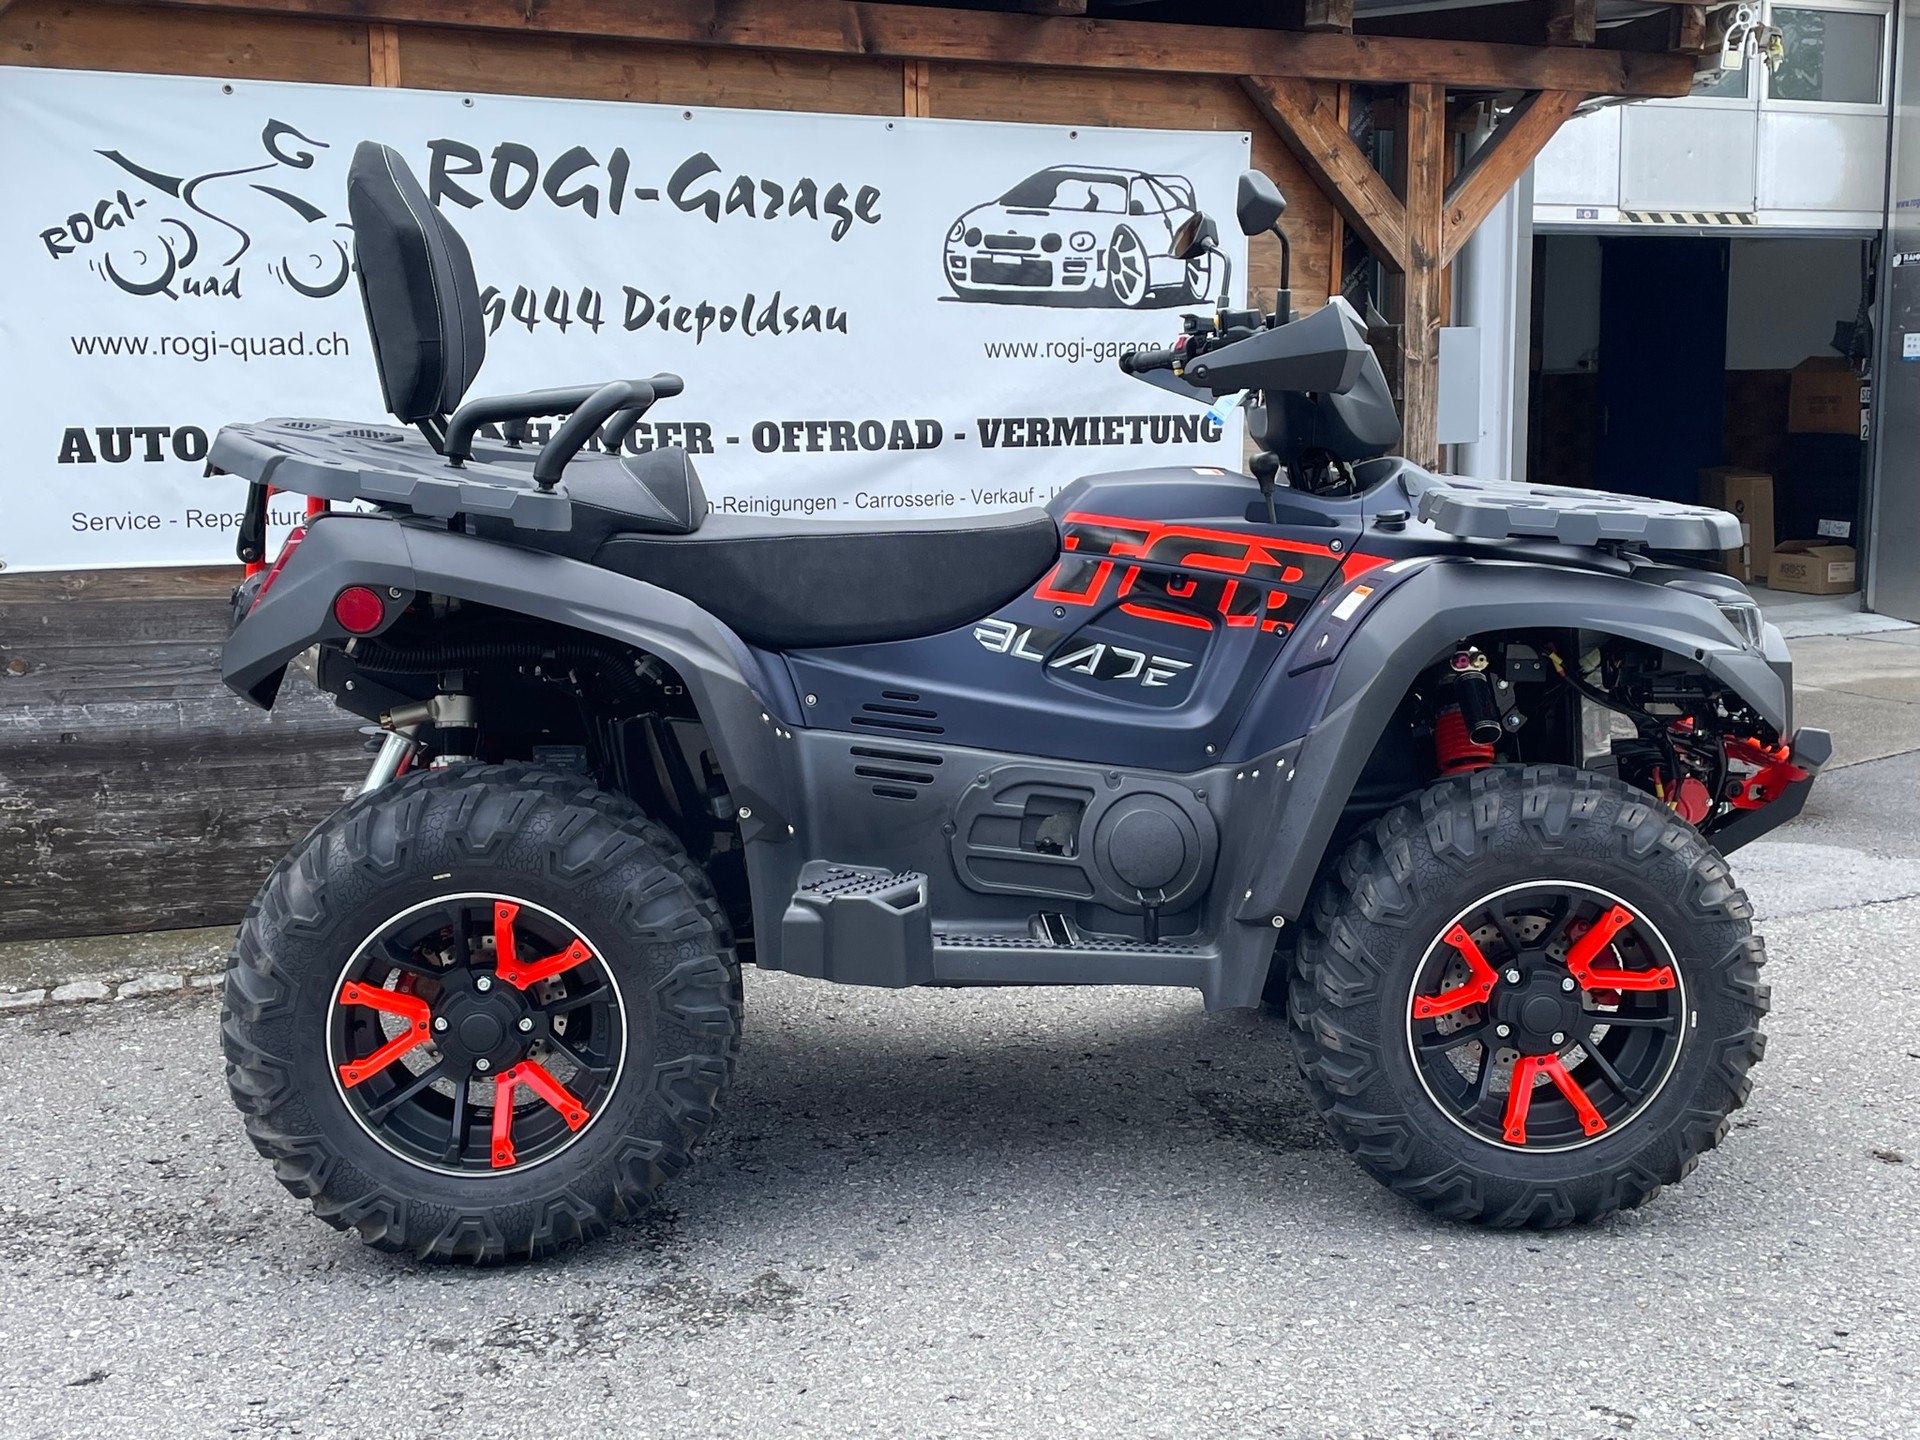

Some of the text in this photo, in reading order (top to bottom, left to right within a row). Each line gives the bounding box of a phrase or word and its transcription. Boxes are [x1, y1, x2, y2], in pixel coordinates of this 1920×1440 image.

[427, 139, 881, 242] ROGI-Garage
[40, 190, 147, 259] ROGI-
[622, 285, 848, 346] Diepoldsau
[71, 330, 349, 362] www.rogi-quad.ch
[984, 337, 1175, 363] www.rogi-garage
[58, 426, 208, 463] AUTO
[752, 419, 943, 454] OFFROAD
[977, 415, 1222, 449] VERMIETUNG
[72, 511, 161, 532] Service
[706, 495, 837, 516] n-Reinigungen
[855, 489, 955, 509] Carrosserie
[970, 486, 1035, 505] Verkauf
[973, 617, 1194, 688] BLADE
